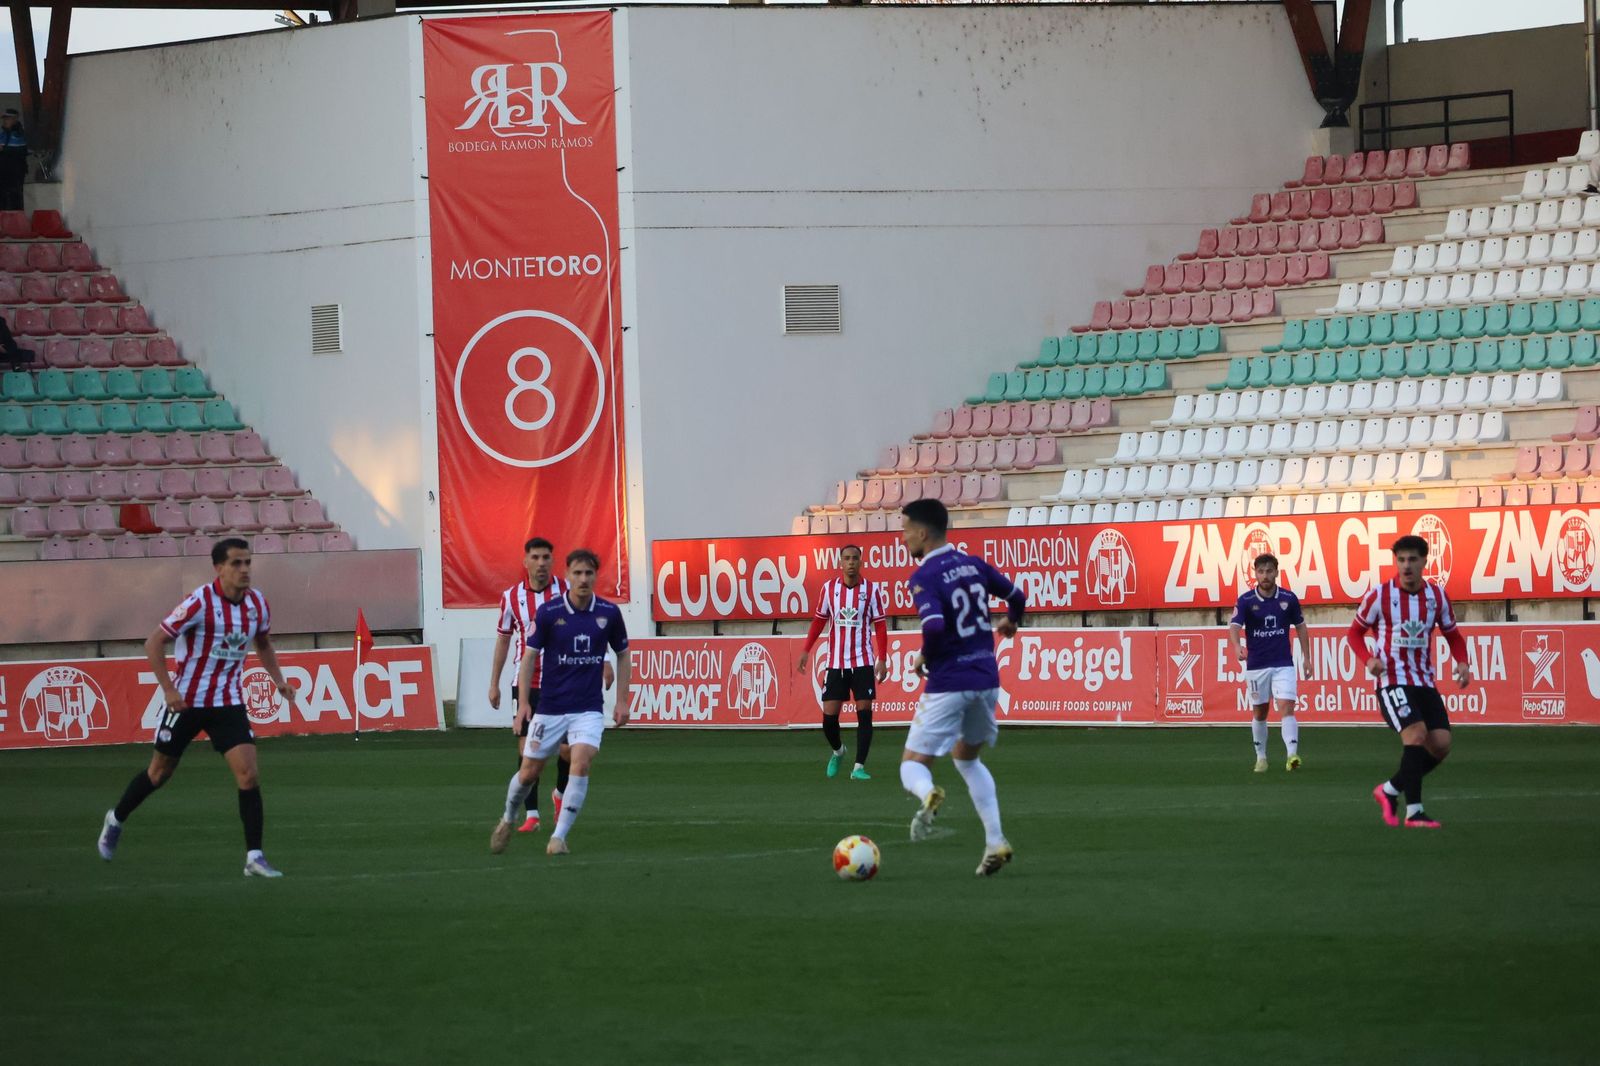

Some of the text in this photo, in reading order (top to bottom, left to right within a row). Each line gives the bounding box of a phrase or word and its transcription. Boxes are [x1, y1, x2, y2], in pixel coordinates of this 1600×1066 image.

[448, 136, 593, 153] BODEGA RAMON RAMOS
[450, 254, 602, 280] MONTETORO
[505, 347, 555, 431] 8
[984, 530, 1079, 568] FUNDACIÓN
[1337, 516, 1398, 599] CF
[657, 543, 808, 617] cubiex
[988, 570, 1079, 608] ORACF
[951, 583, 992, 638] 23
[629, 642, 722, 681] FUNDACIÓN
[1018, 636, 1133, 691] Freigel
[1293, 636, 1357, 682] MINO
[138, 660, 423, 729] ZORA CF
[628, 683, 722, 720] ZAMORACF
[881, 702, 906, 712] FOODS
[1013, 701, 1132, 711] A GOODLIFE FOODS COMPANY
[1315, 685, 1341, 711] del
[1347, 687, 1380, 711] Vin
[1388, 686, 1408, 707] 19
[1523, 699, 1565, 715] RepoSTAR
[531, 722, 545, 740] 14
